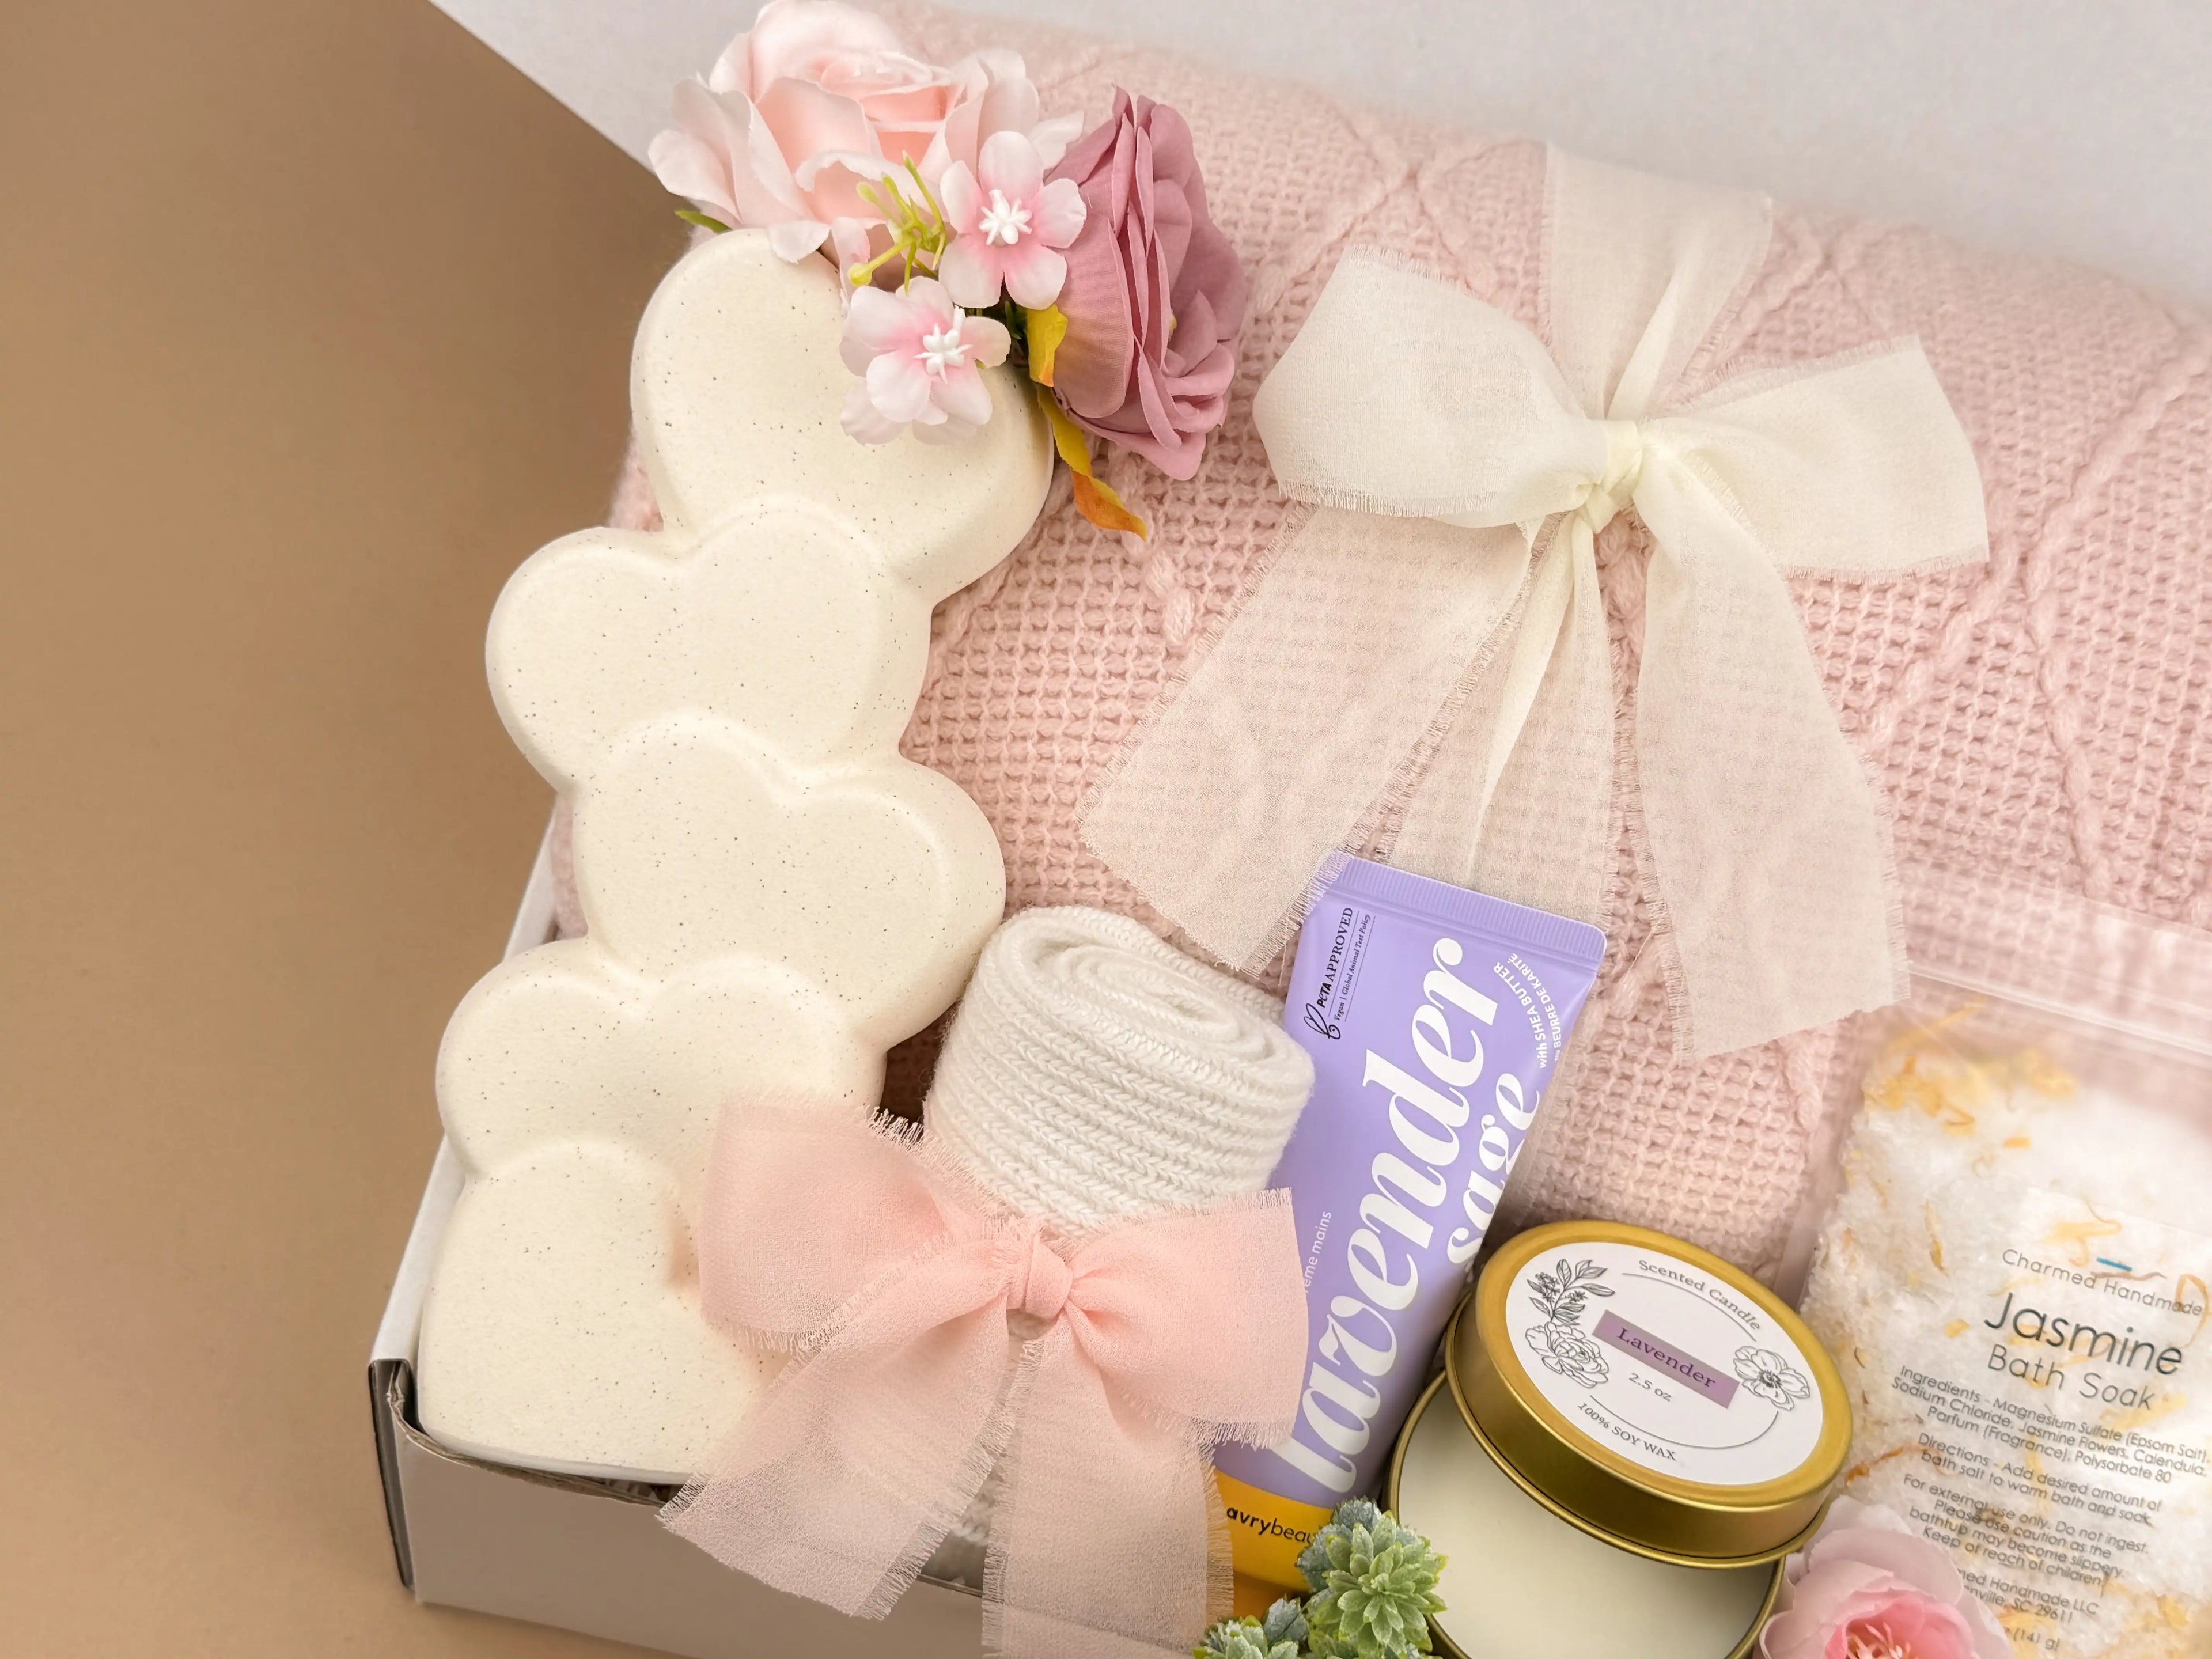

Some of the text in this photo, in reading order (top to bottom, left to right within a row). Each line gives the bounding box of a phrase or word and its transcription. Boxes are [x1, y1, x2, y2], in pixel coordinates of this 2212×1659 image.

[1325, 908, 1353, 982] APPROVED
[1334, 1002, 1344, 1021] Vegan
[1342, 974, 1353, 995] Global
[1351, 950, 1359, 974] Animal
[1355, 933, 1363, 948] Test
[1359, 914, 1371, 933] Policy
[1493, 962, 1547, 1068] with SHEA BUTTER
[1536, 987, 1551, 1004] DE
[1544, 1003, 1562, 1048] BEURRE
[1447, 1073, 1540, 1264] sage
[1268, 937, 1498, 1493] lavender
[1312, 1211, 1331, 1254] mains
[1639, 1260, 1760, 1330] Scented Candle
[2003, 1249, 2203, 1316] Charmed Handmade
[1616, 1327, 1716, 1387] Lavender
[1983, 1292, 2183, 1375] Jasmine
[1629, 1373, 1672, 1402] 2.5 oz
[1901, 1365, 1980, 1402] Ingredients
[1993, 1397, 2075, 1431] Magnesium
[2078, 1422, 2122, 1441] Sulfate
[2126, 1432, 2175, 1454] (Epsom
[1987, 1343, 2156, 1411] Bath Soak
[1578, 1403, 1676, 1461] 100% SOY WAX
[1892, 1377, 1946, 1406] Sodium
[2019, 1422, 2075, 1445] Jasmine
[1927, 1406, 1979, 1433] Parfum
[2075, 1450, 2152, 1479] Polysorbate
[2155, 1471, 2172, 1483] 80
[1918, 1433, 1990, 1466] Directions
[2002, 1462, 2033, 1480] Add
[2037, 1473, 2089, 1495] desired
[2092, 1487, 2145, 1508] amount
[2147, 1499, 2162, 1512] of
[1921, 1449, 1956, 1470] bath
[1959, 1464, 1985, 1480] salt
[1990, 1472, 2003, 1486] to
[2008, 1480, 2047, 1499] warm
[2051, 1490, 2085, 1509] bath
[2088, 1501, 2116, 1516] and
[1227, 1507, 1315, 1544] avrybeau
[1903, 1473, 1926, 1490] For
[1929, 1485, 1988, 1510] external
[1991, 1505, 2016, 1520] use
[2055, 1520, 2075, 1535] Do
[2079, 1528, 2104, 1542] not
[2105, 1533, 2148, 1554] ingest.
[1910, 1506, 1968, 1535] bathtub
[1972, 1529, 2005, 1548] may
[2008, 1537, 2067, 1562] become
[1934, 1499, 2112, 1559] Please use caution as the
[1922, 1526, 1961, 1549] Keep
[1965, 1541, 1981, 1554] of
[1983, 1548, 2025, 1567] reach
[2029, 1559, 2044, 1571] of
[1990, 1577, 2100, 1615] Handmade LLC
[2012, 1597, 2032, 1613] SC
[2035, 1604, 2073, 1623] 29611
